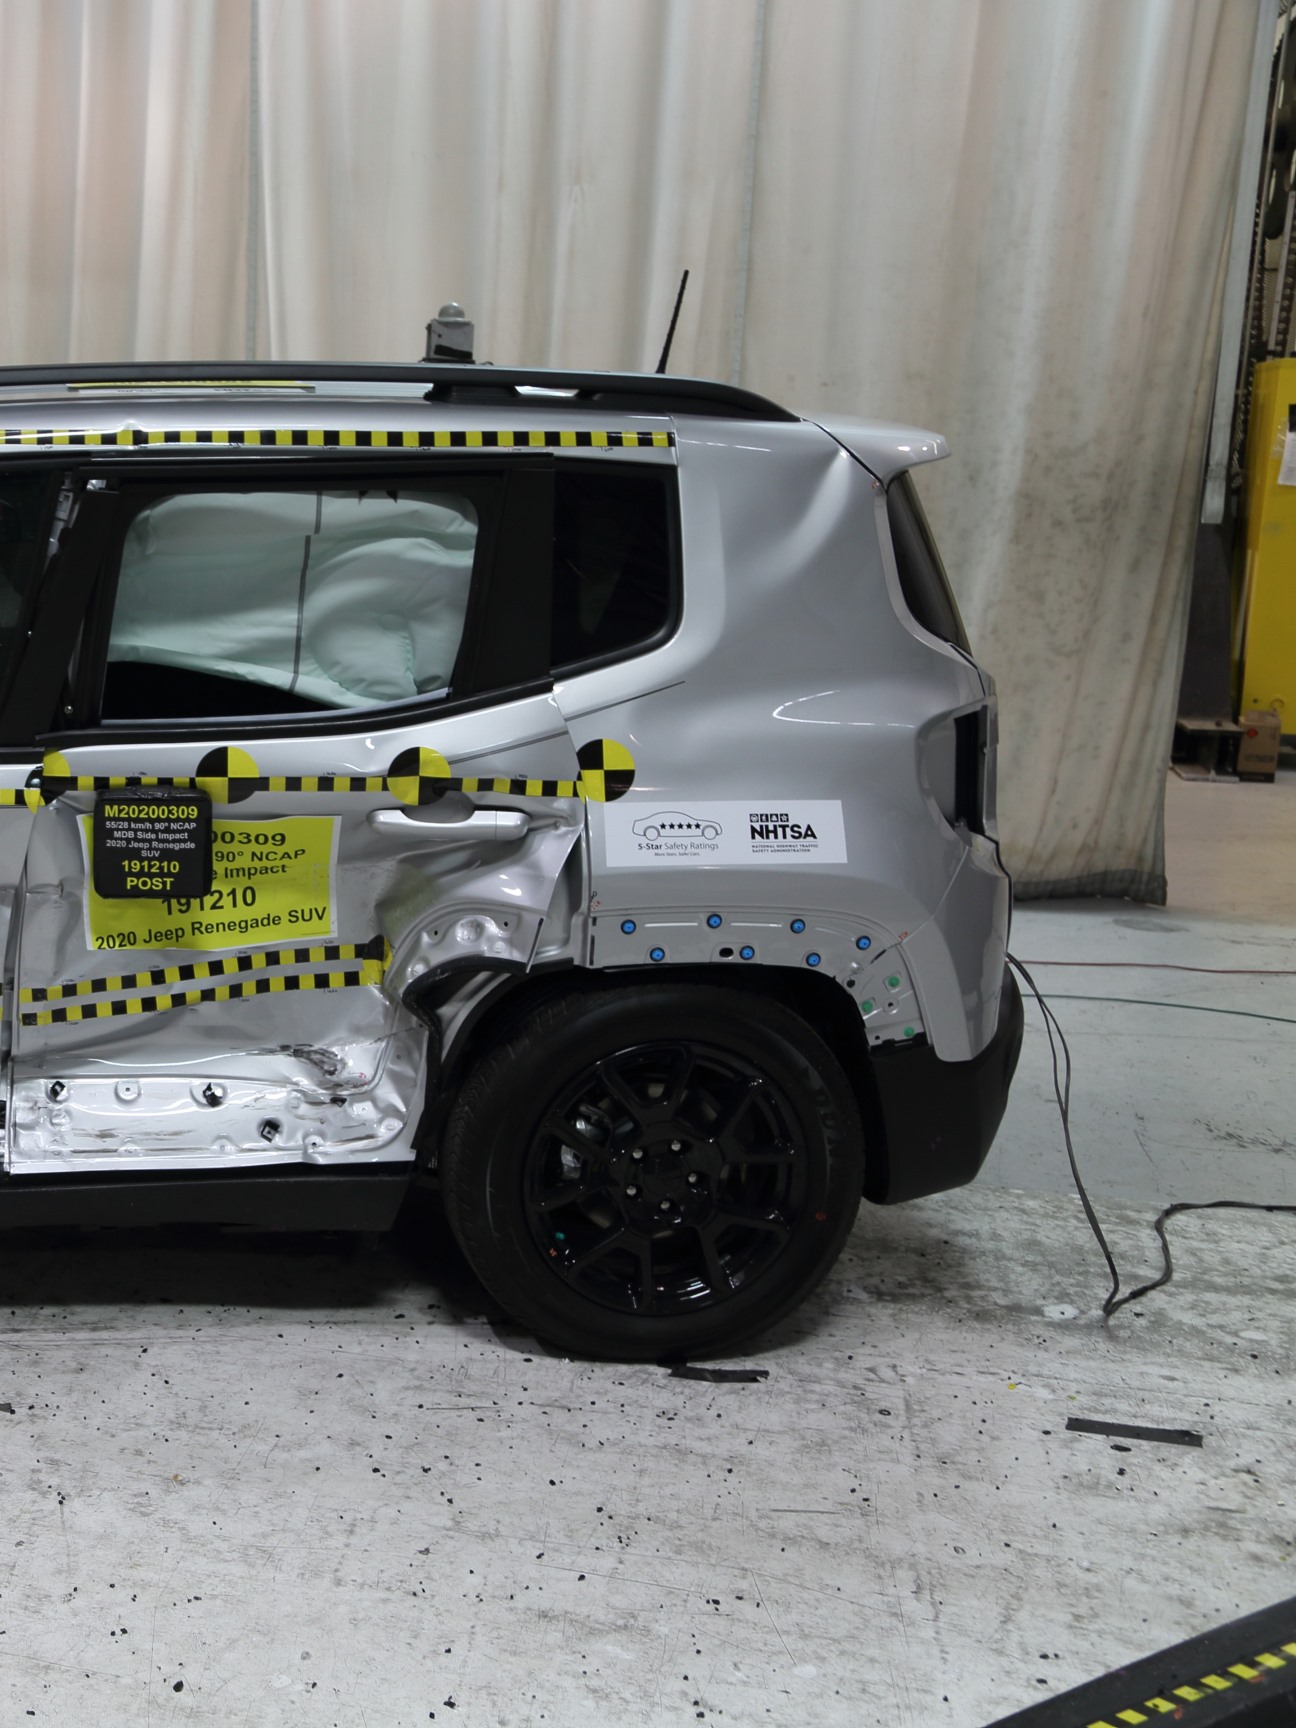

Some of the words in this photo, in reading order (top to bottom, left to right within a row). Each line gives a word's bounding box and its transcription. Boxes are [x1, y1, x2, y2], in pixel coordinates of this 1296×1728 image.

[105, 805, 198, 819] M20200309
[105, 821, 129, 829] 55/28
[170, 822, 197, 830] NCAP
[750, 824, 817, 840] NHTSA
[137, 831, 156, 839] Side
[158, 832, 188, 840] Impact
[128, 841, 150, 849] Jeep
[152, 841, 196, 850] Renegade
[664, 842, 688, 851] Safety
[690, 842, 719, 851] Ratings
[215, 851, 245, 863] 90°
[250, 848, 306, 863] NCAP
[121, 860, 180, 873] 191210
[225, 864, 287, 881] Impact
[126, 877, 175, 890] POST
[161, 886, 257, 916] 191210
[95, 931, 137, 950] 2020
[143, 924, 185, 944] Jeep
[191, 913, 282, 937] Renegade
[288, 906, 327, 924] SUV
